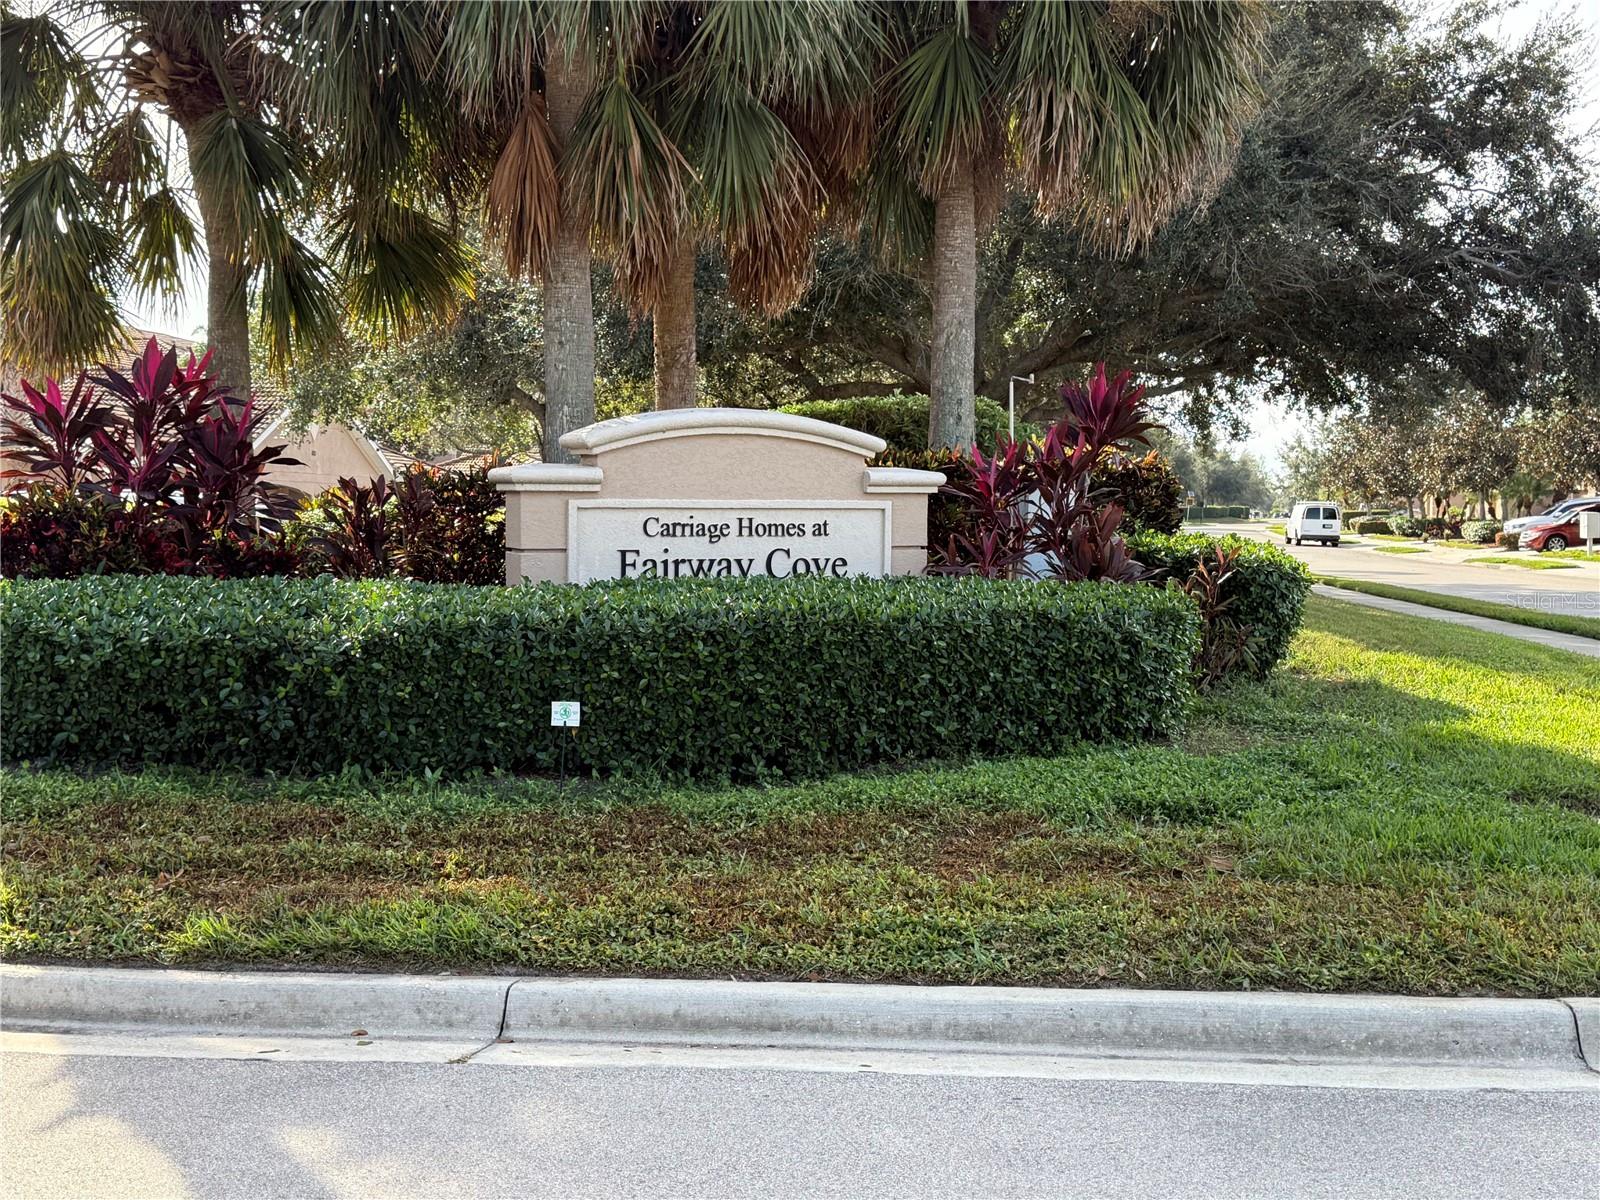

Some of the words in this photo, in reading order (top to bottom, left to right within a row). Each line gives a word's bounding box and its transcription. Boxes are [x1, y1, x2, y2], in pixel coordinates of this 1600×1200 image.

[642, 516, 731, 543] Carriage
[736, 517, 806, 538] Homes
[811, 519, 830, 537] at
[765, 547, 848, 579] Cove
